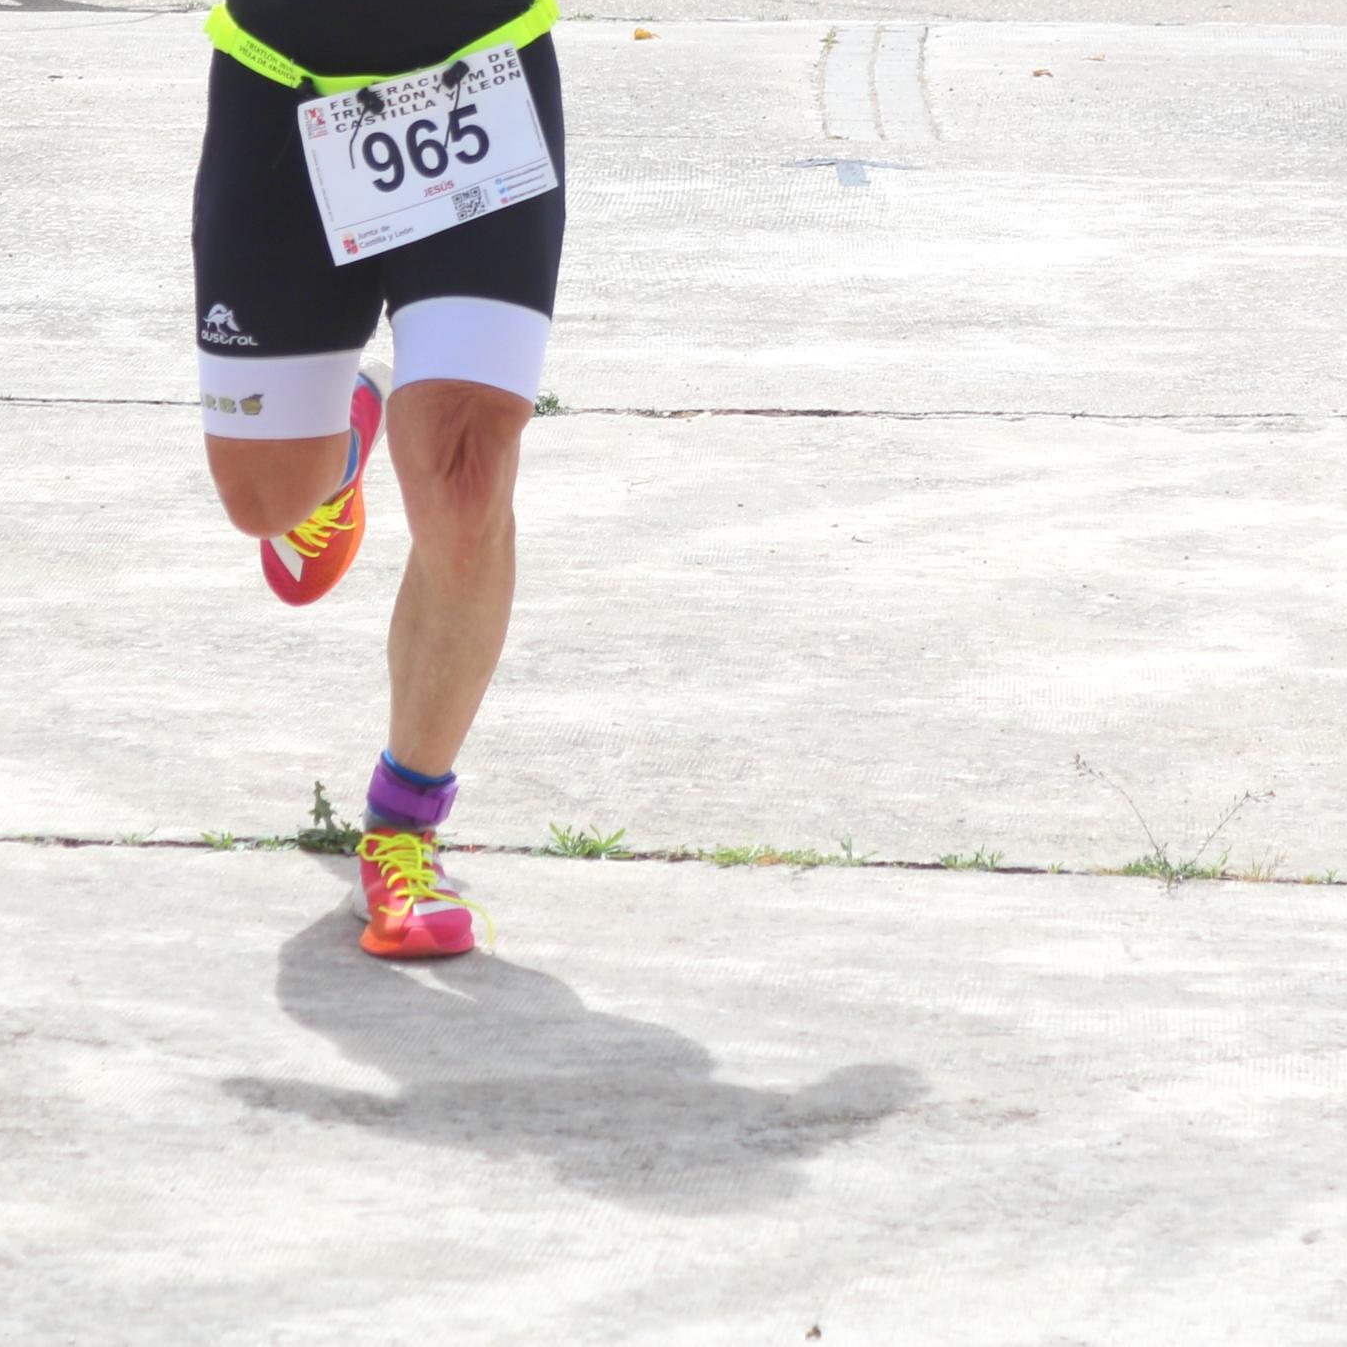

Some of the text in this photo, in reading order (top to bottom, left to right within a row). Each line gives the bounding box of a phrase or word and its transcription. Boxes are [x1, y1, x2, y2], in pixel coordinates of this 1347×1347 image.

[488, 48, 515, 64] DE
[493, 57, 519, 74] DE
[336, 99, 437, 133] CASTILLA
[467, 69, 522, 95] LEON
[361, 104, 490, 192] 965
[423, 180, 456, 198] JESÚS
[359, 235, 387, 249] Castilla
